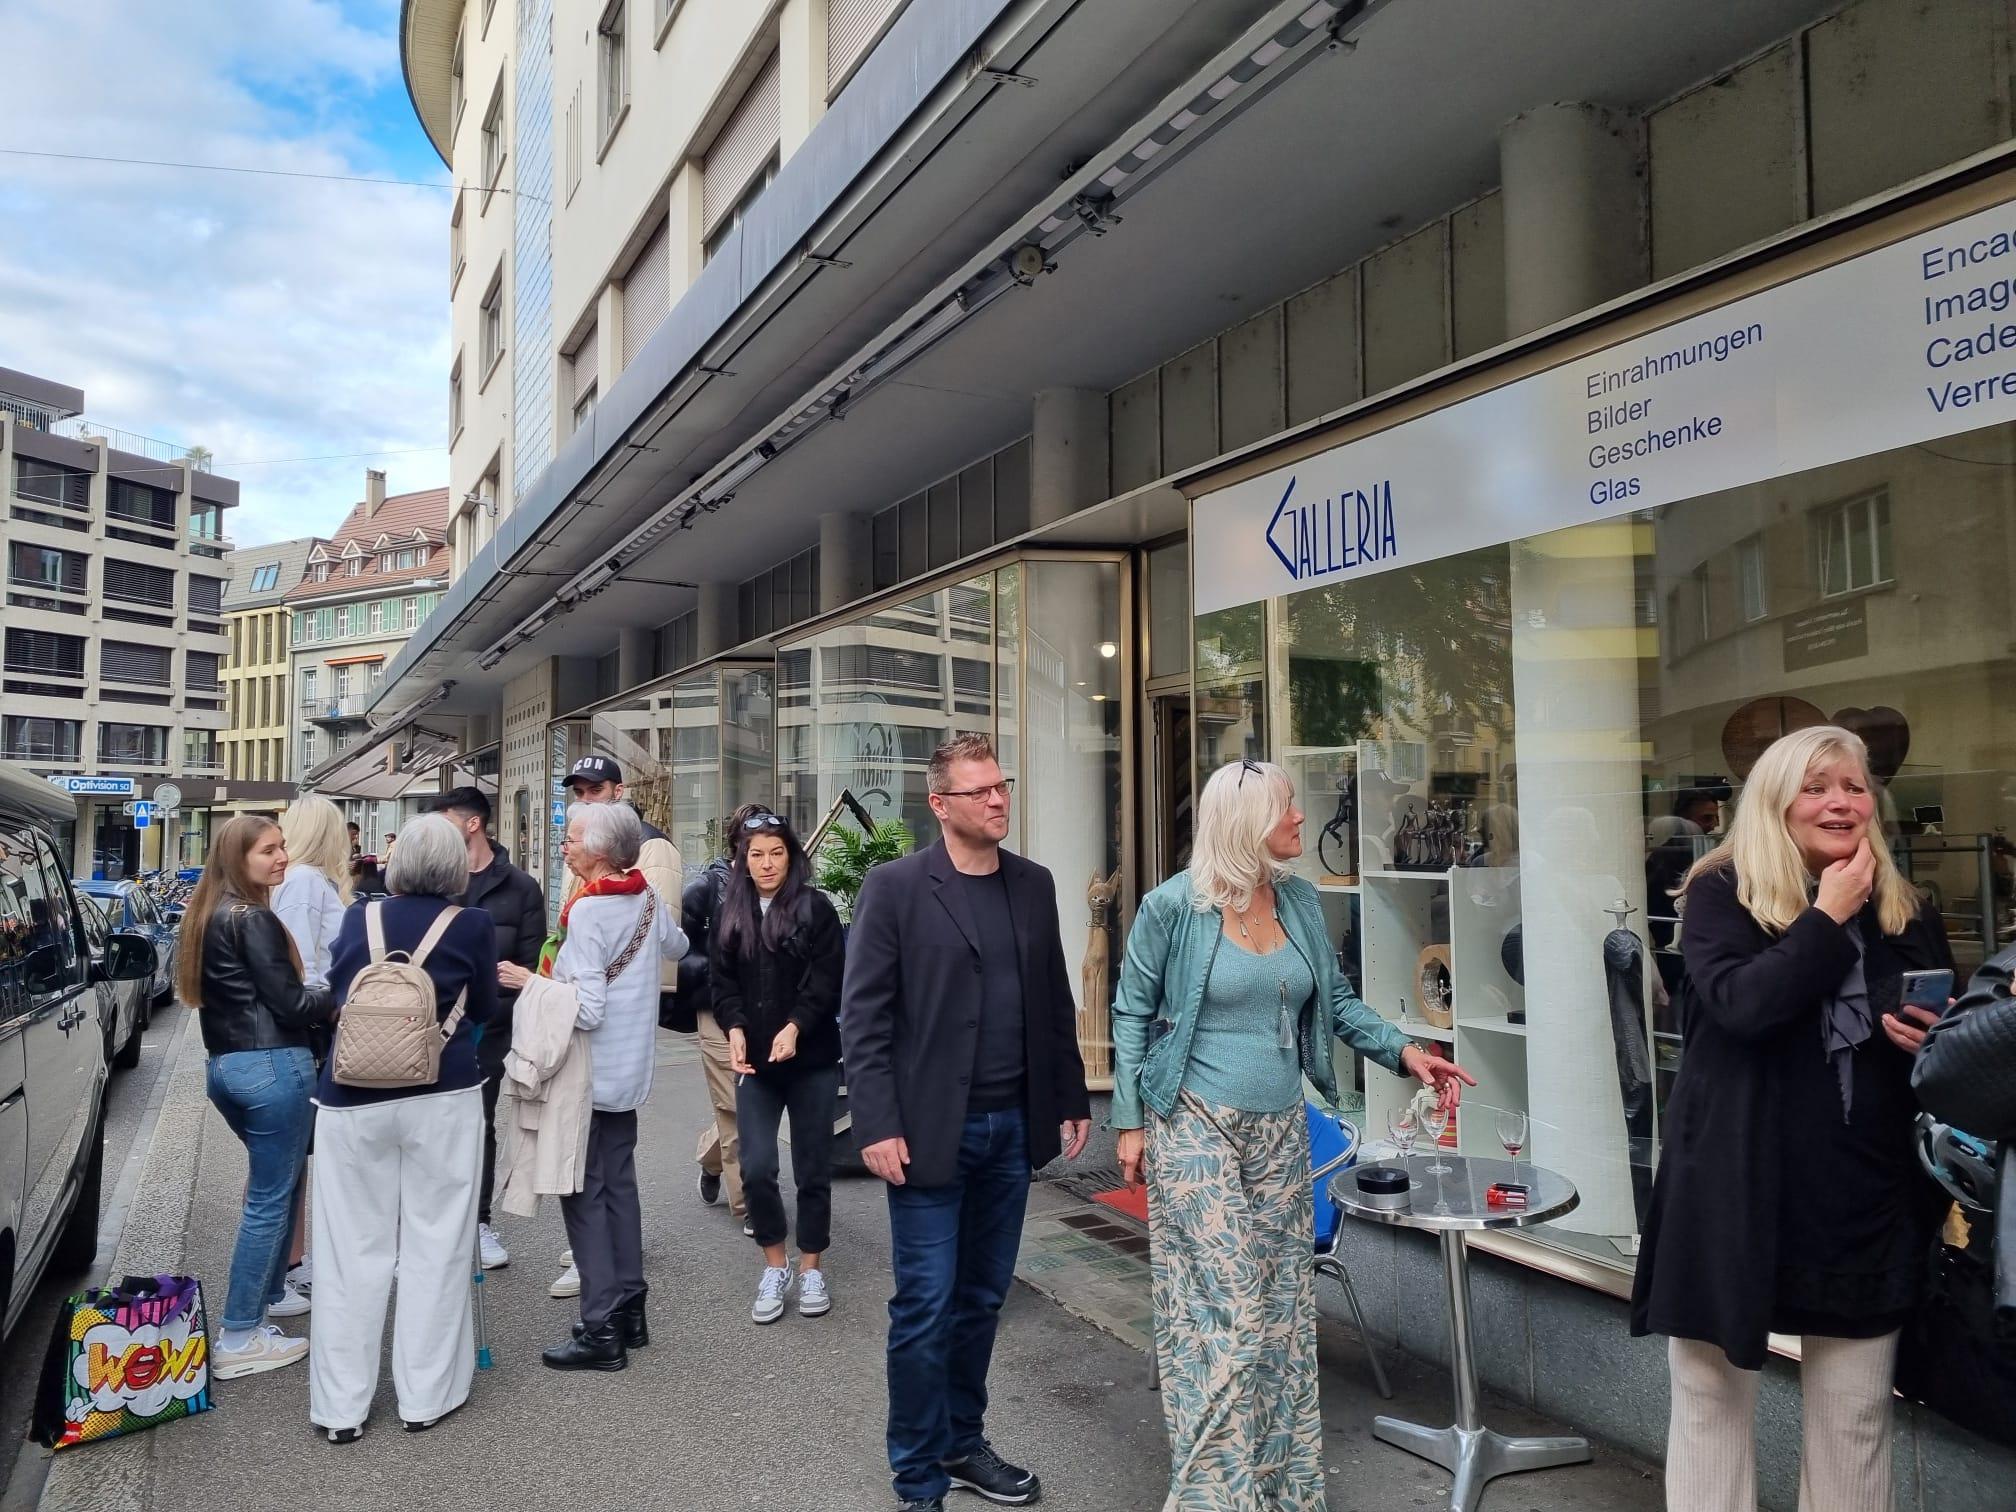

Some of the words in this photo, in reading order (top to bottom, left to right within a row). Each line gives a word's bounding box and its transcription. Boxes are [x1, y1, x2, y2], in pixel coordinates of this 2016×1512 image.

[1922, 230, 2016, 280] Enca
[1925, 277, 2016, 325] Imag
[1587, 323, 1763, 399] Einrahmungen
[1588, 398, 1652, 434] Bilder
[1589, 416, 1722, 469] Geschenke
[1590, 477, 1641, 505] Glas
[1266, 475, 1397, 580] GALLERIA
[70, 779, 118, 791] Optivision
[88, 1336, 206, 1394] WOW!
